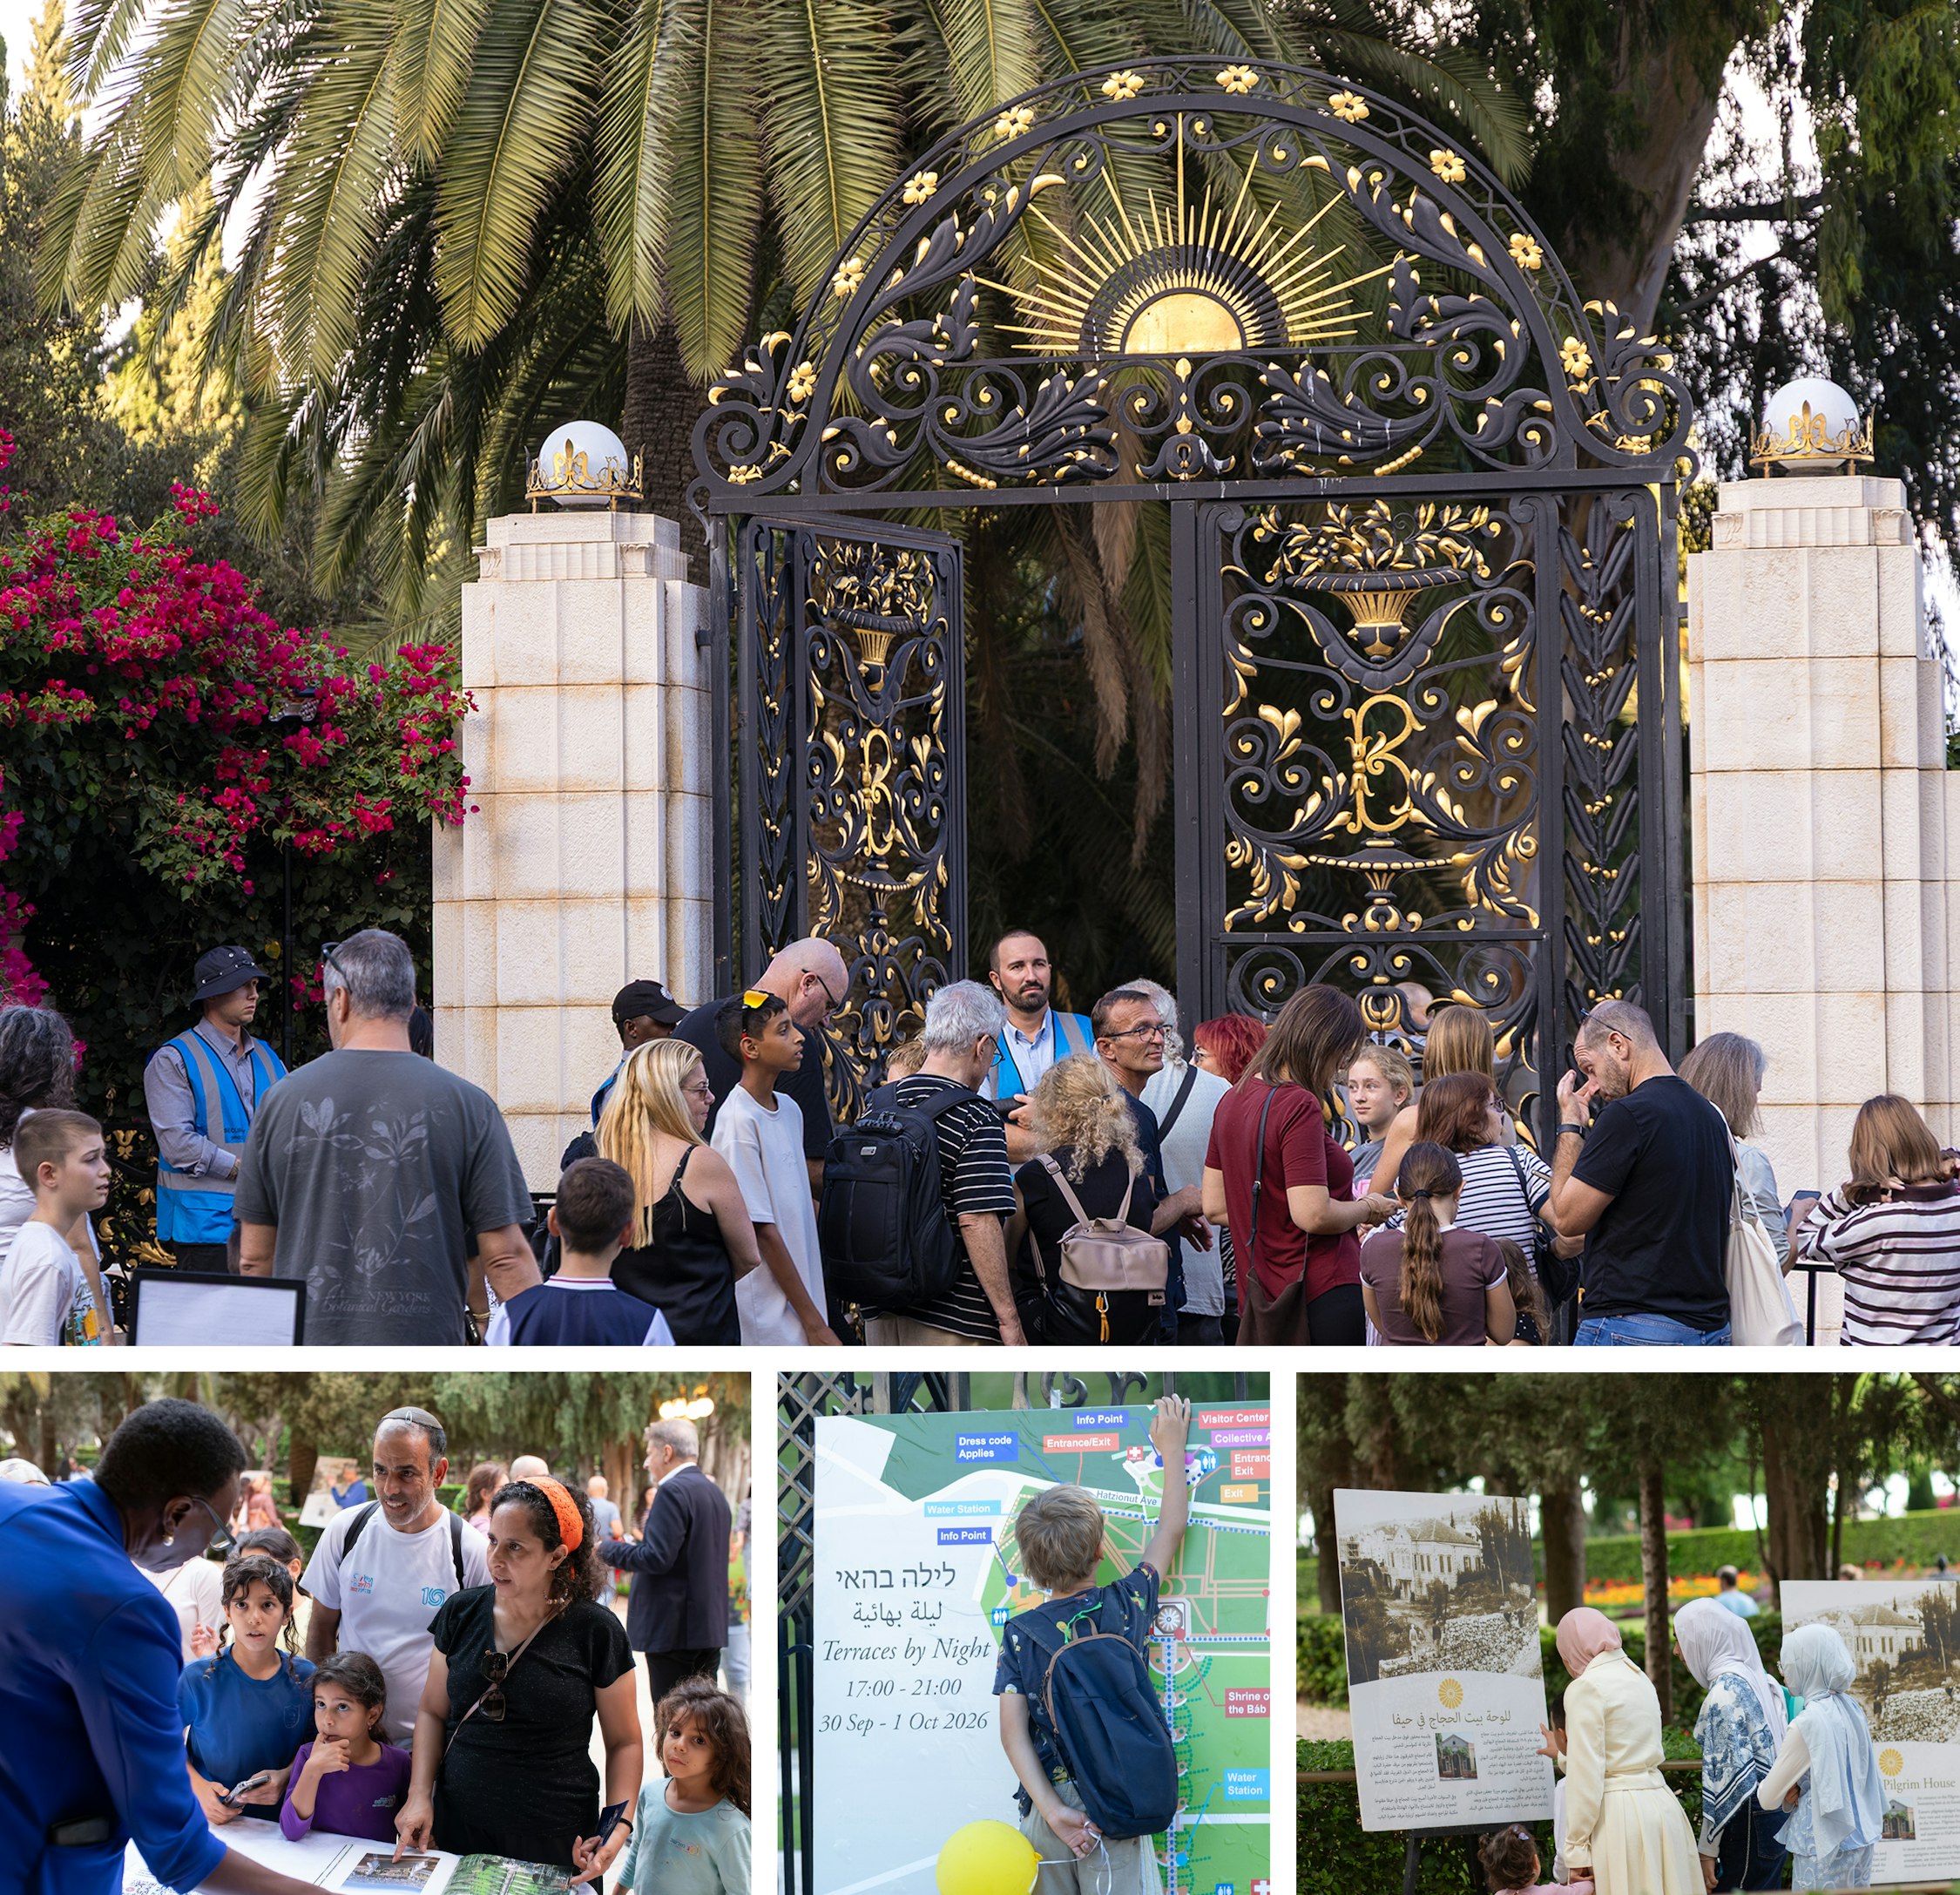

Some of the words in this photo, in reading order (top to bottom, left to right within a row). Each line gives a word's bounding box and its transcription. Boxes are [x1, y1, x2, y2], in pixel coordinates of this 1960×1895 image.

[1076, 1415, 1096, 1425] Info
[1098, 1413, 1124, 1425] Point
[1201, 1414, 1233, 1425] Visitor
[1236, 1412, 1268, 1423] Center
[958, 1436, 987, 1446] Dress
[988, 1436, 1012, 1445] code
[1046, 1438, 1111, 1449] Entrance/Exit
[1214, 1432, 1263, 1444] Collective
[958, 1448, 995, 1460] Applies
[1234, 1466, 1254, 1476] Exit
[1096, 1490, 1138, 1504] Hatzionut
[1140, 1496, 1158, 1506] Ave
[1224, 1488, 1244, 1499] Exit
[927, 1505, 956, 1514] Water
[957, 1504, 990, 1513] Station
[940, 1531, 959, 1541] Info
[961, 1530, 987, 1540] Point
[835, 1569, 894, 1589] בהאי
[902, 1561, 956, 1587] לילה
[853, 1601, 902, 1628] بهائية
[910, 1601, 943, 1627] ليلة
[822, 1640, 897, 1662] Terraces
[904, 1637, 926, 1666] by
[931, 1636, 992, 1666] Night
[846, 1679, 896, 1698] 17:00
[911, 1678, 963, 1696] 21:00
[1228, 1691, 1260, 1702] Shrine
[1227, 1704, 1245, 1715] the
[1247, 1703, 1267, 1714] Báb
[818, 1715, 842, 1733] 30
[846, 1713, 874, 1737] Sep
[893, 1714, 902, 1730] 1
[909, 1712, 939, 1730] Oct
[943, 1710, 990, 1730] 2026
[1392, 1713, 1413, 1729] حيفا
[1416, 1712, 1426, 1729] في
[1429, 1711, 1461, 1729] الحجاج
[1463, 1713, 1484, 1726] بيت
[1486, 1710, 1511, 1725] للوحة
[1227, 1772, 1257, 1783] Water
[1227, 1785, 1263, 1796] Station
[1883, 1778, 1920, 1794] Pilgrim
[1923, 1777, 1957, 1789] House
